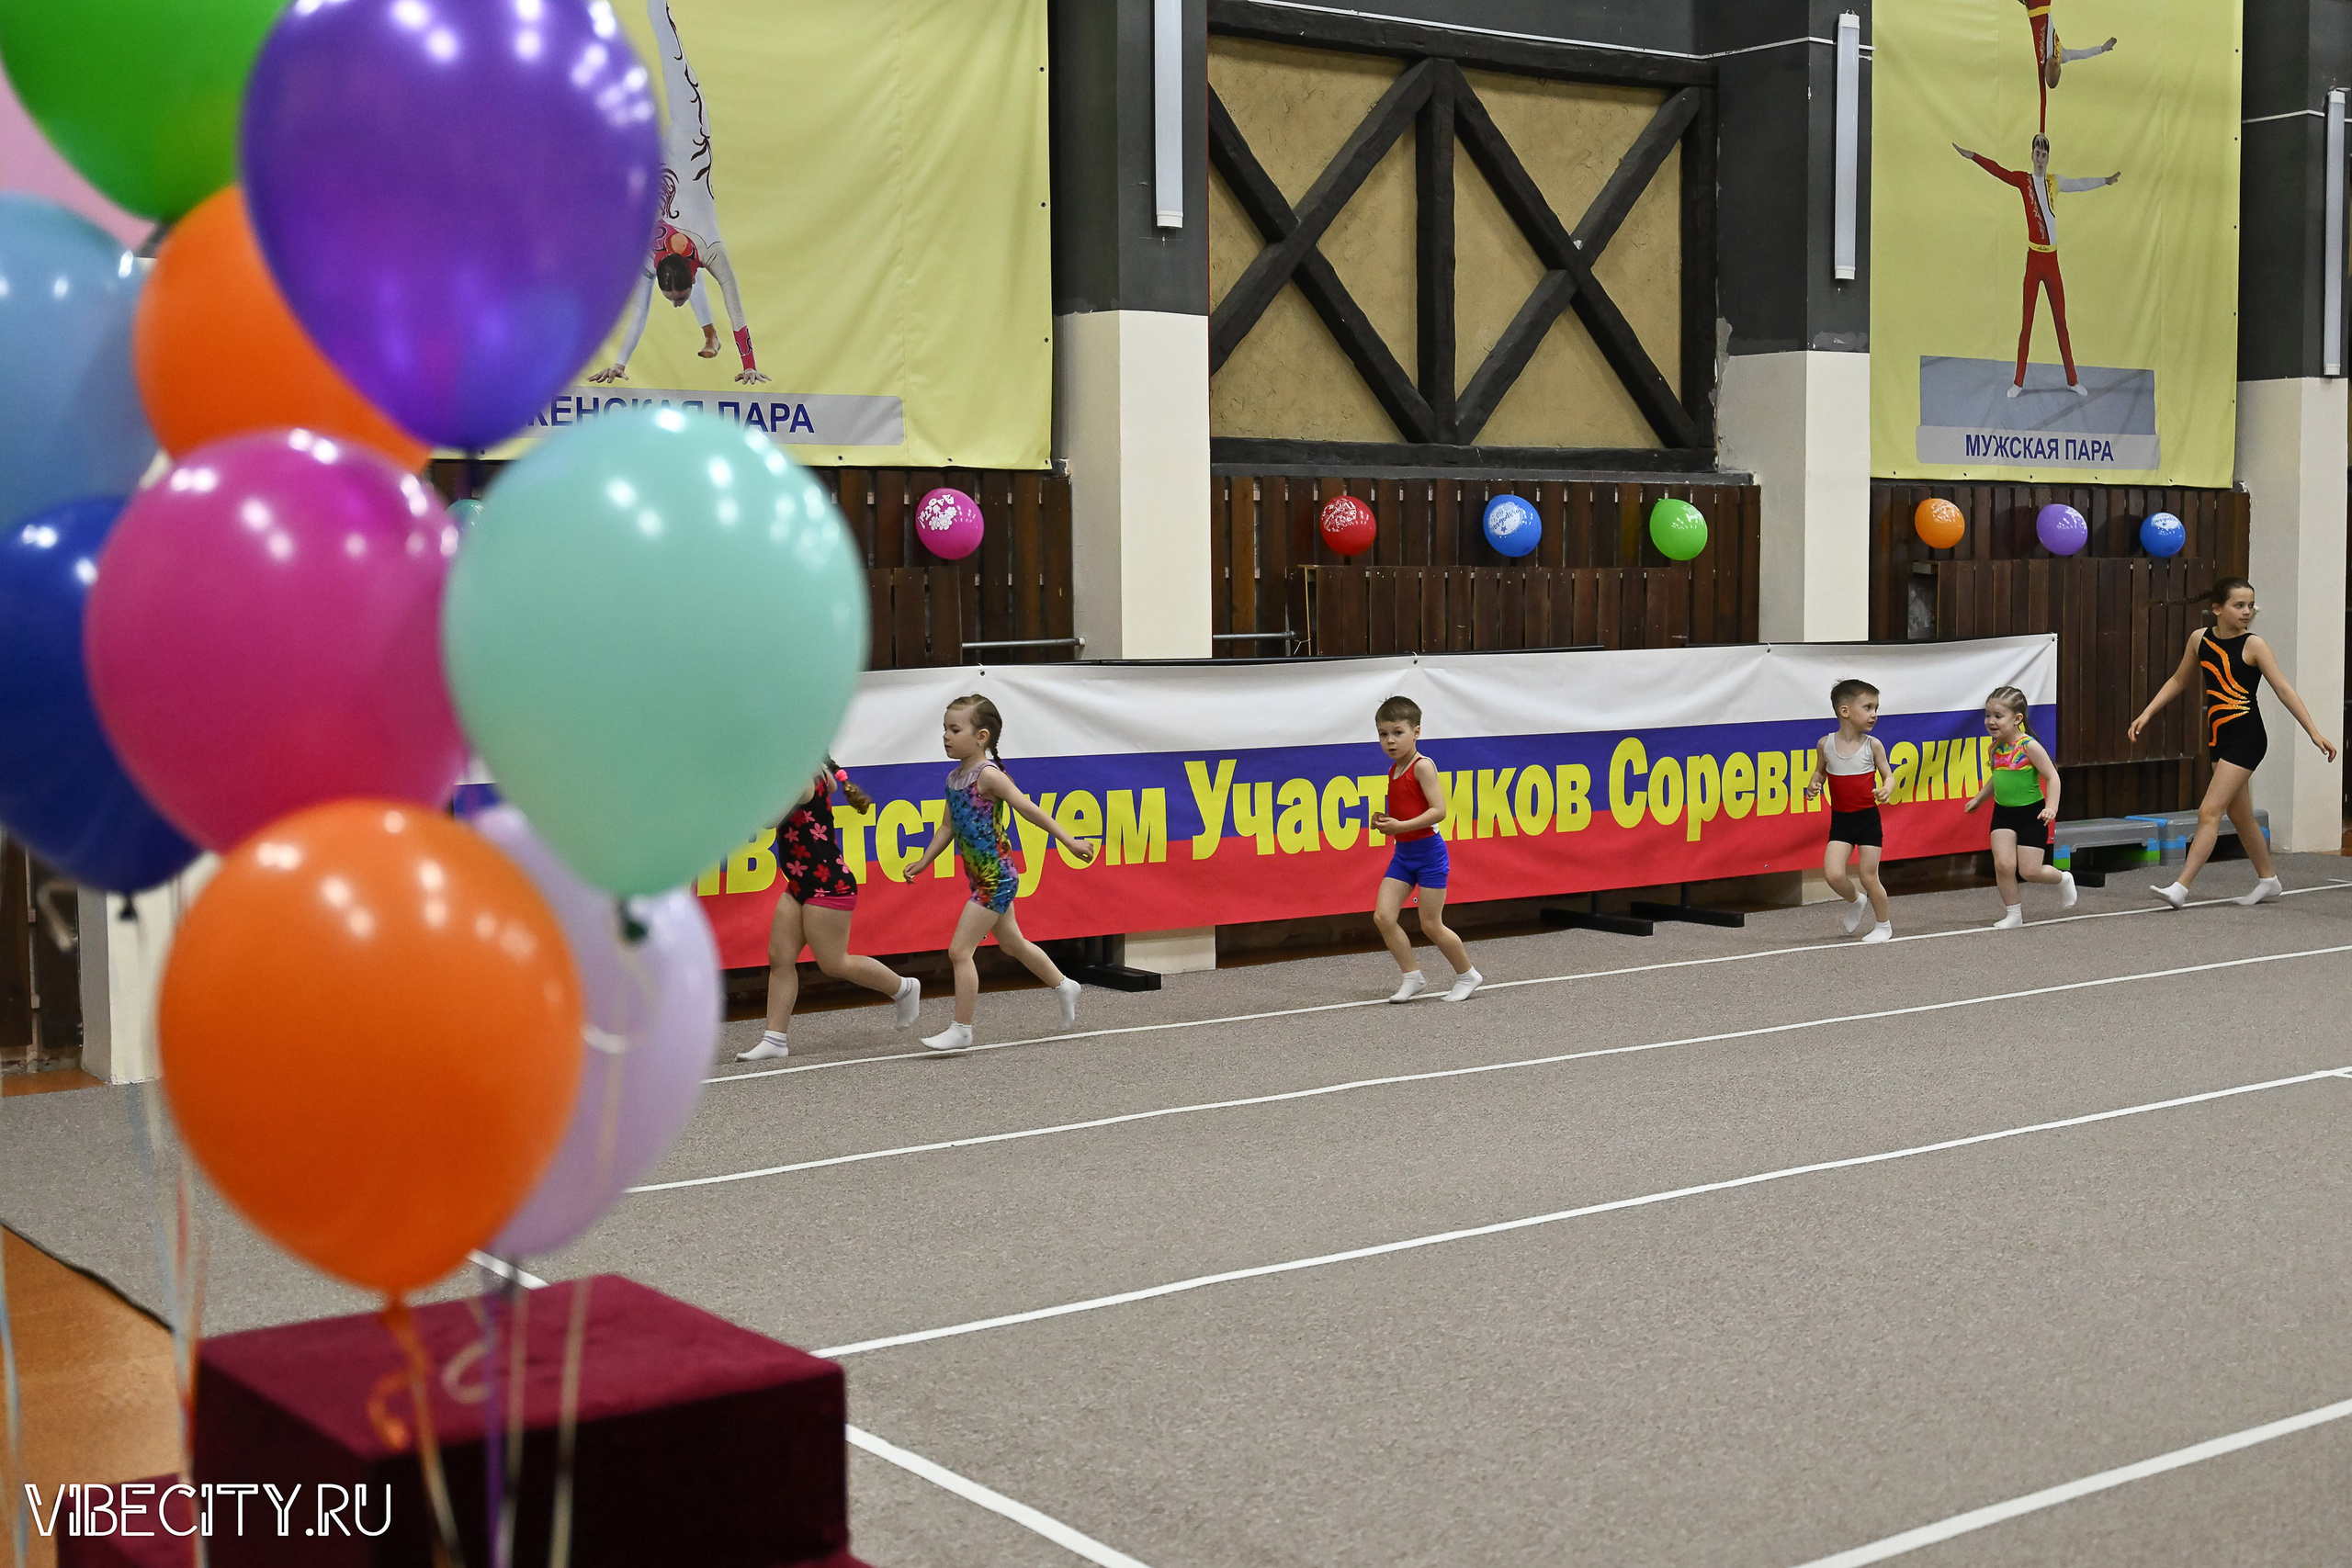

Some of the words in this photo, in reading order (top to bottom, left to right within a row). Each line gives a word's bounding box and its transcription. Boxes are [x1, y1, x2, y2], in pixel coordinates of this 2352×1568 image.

[718, 400, 815, 434] ПАРА
[1965, 434, 2059, 459] МУЖСКАЯ
[2065, 439, 2115, 461] ПАРА
[1184, 759, 1591, 860] Участиков
[1609, 731, 2012, 842] Соревнани
